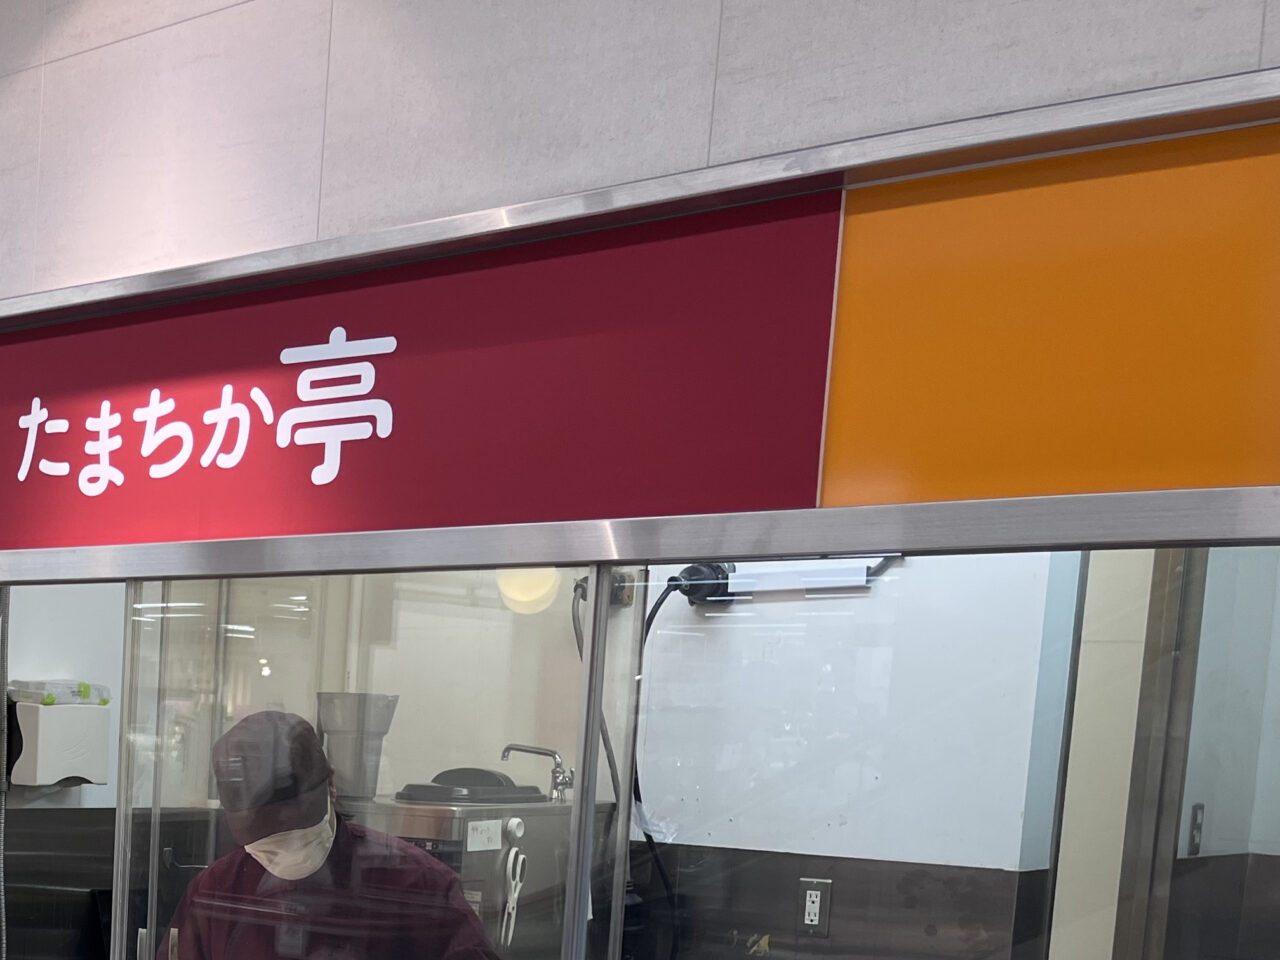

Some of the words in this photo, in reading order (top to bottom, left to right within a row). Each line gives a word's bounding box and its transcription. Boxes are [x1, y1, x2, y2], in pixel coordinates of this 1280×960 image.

[18, 326, 398, 496] たまちか亭
